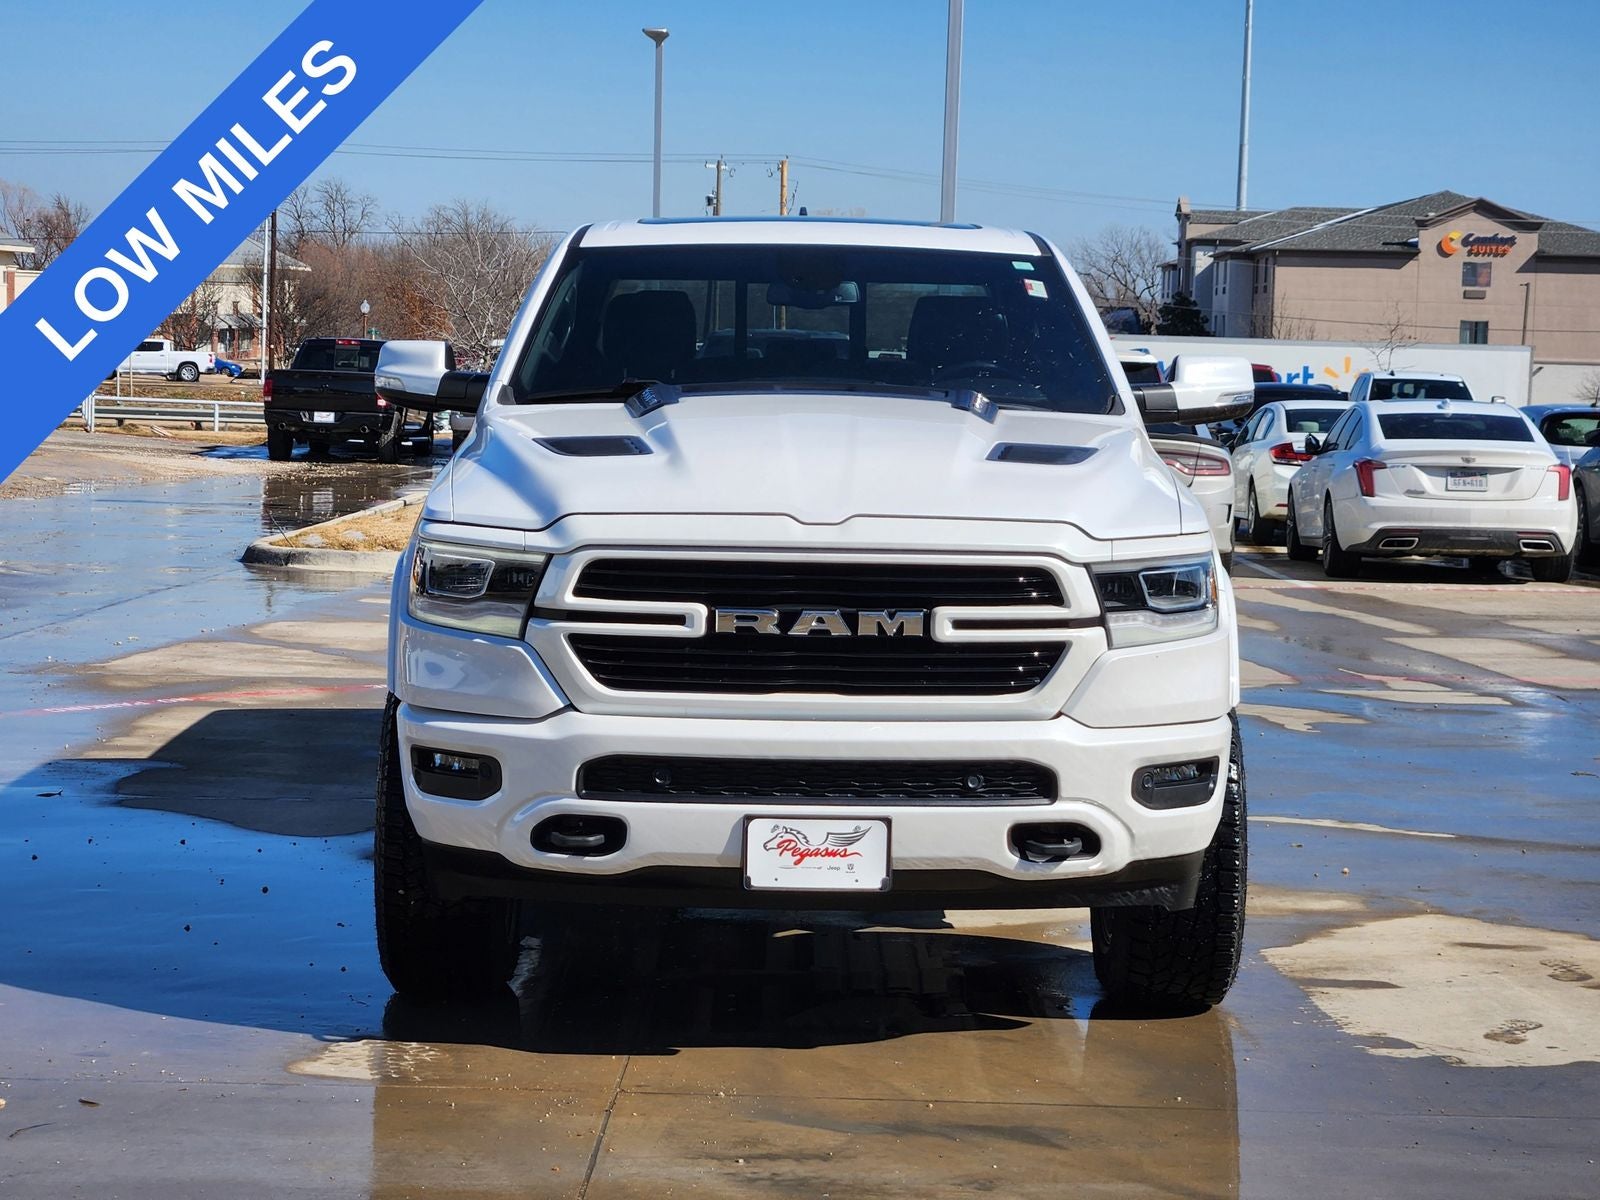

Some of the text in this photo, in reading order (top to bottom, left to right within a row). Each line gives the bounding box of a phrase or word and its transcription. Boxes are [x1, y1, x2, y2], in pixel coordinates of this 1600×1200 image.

[1471, 245, 1513, 254] SUITES
[714, 608, 925, 636] RAM
[776, 838, 864, 867] Pegasus
[826, 864, 841, 872] Jeep
